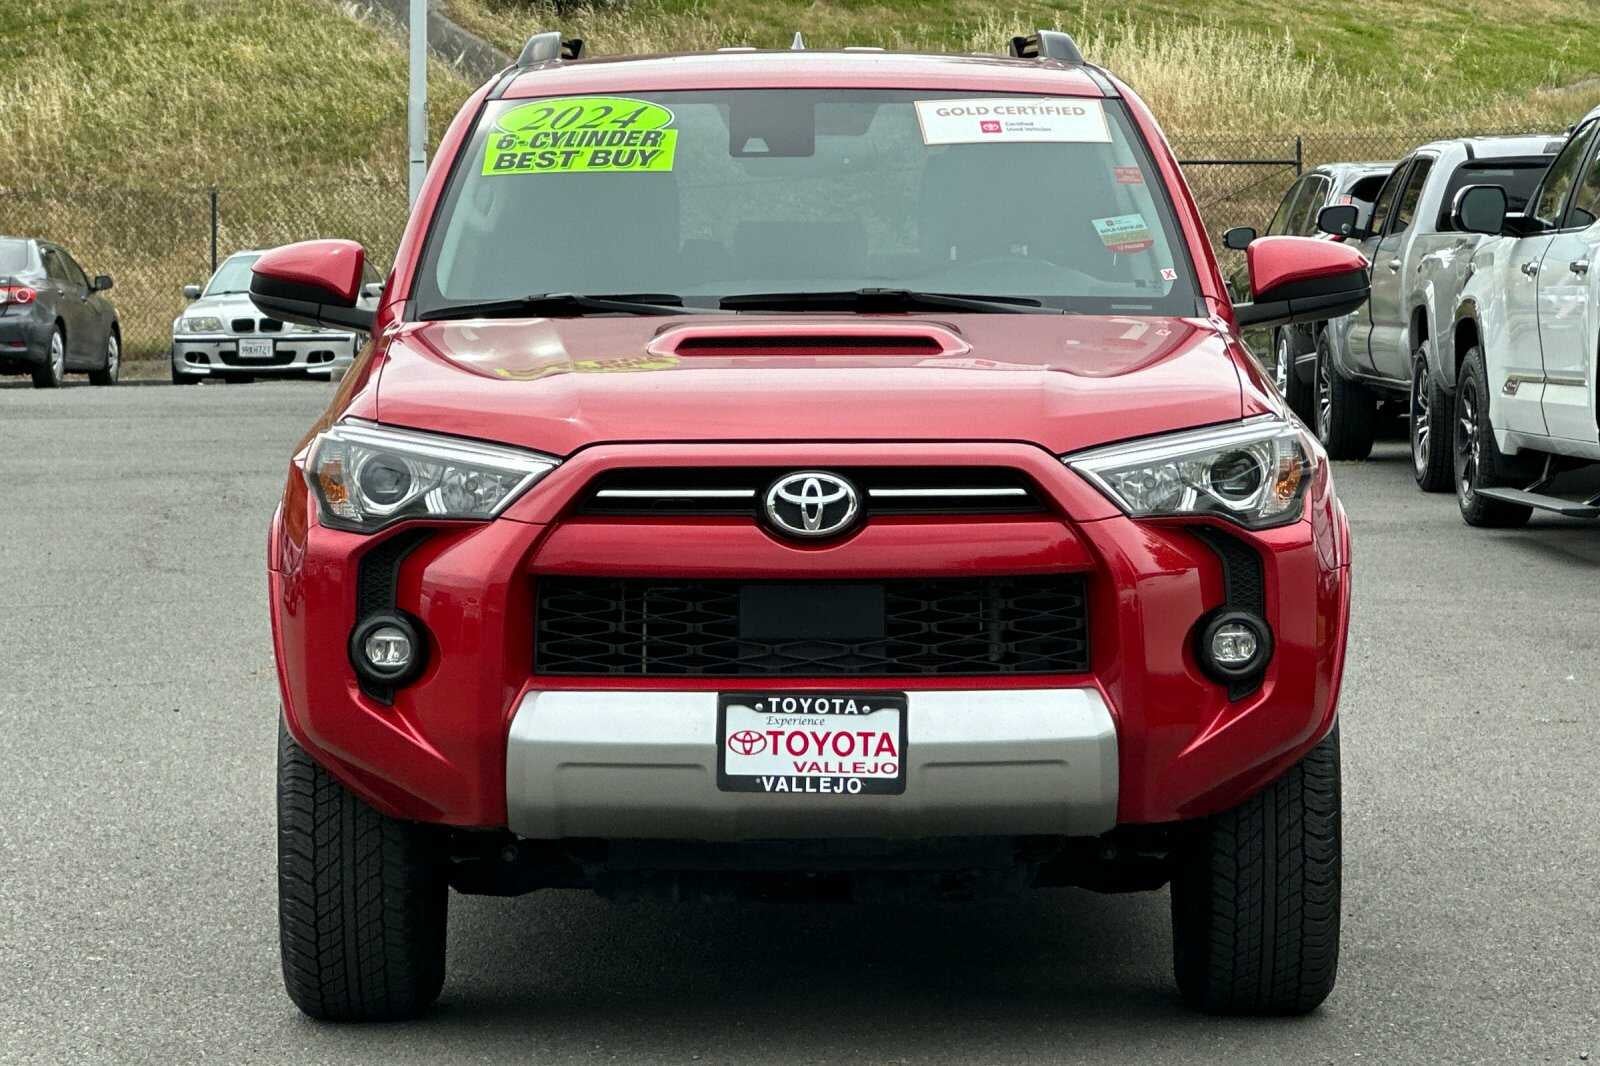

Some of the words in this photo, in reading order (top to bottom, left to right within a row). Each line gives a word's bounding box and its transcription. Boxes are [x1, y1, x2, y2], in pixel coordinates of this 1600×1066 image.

[516, 105, 649, 132] 2024
[936, 107, 990, 117] GOLD
[993, 106, 1086, 116] CERTIFIED
[496, 129, 667, 150] 6-CYLINDER
[493, 149, 583, 170] BEST
[587, 149, 665, 168] BUY
[768, 697, 859, 714] TOYOTA
[766, 715, 825, 728] Experience
[766, 730, 898, 757] TOYOTA
[793, 761, 898, 775] VALLEJO
[761, 776, 862, 794] VALLEJO
